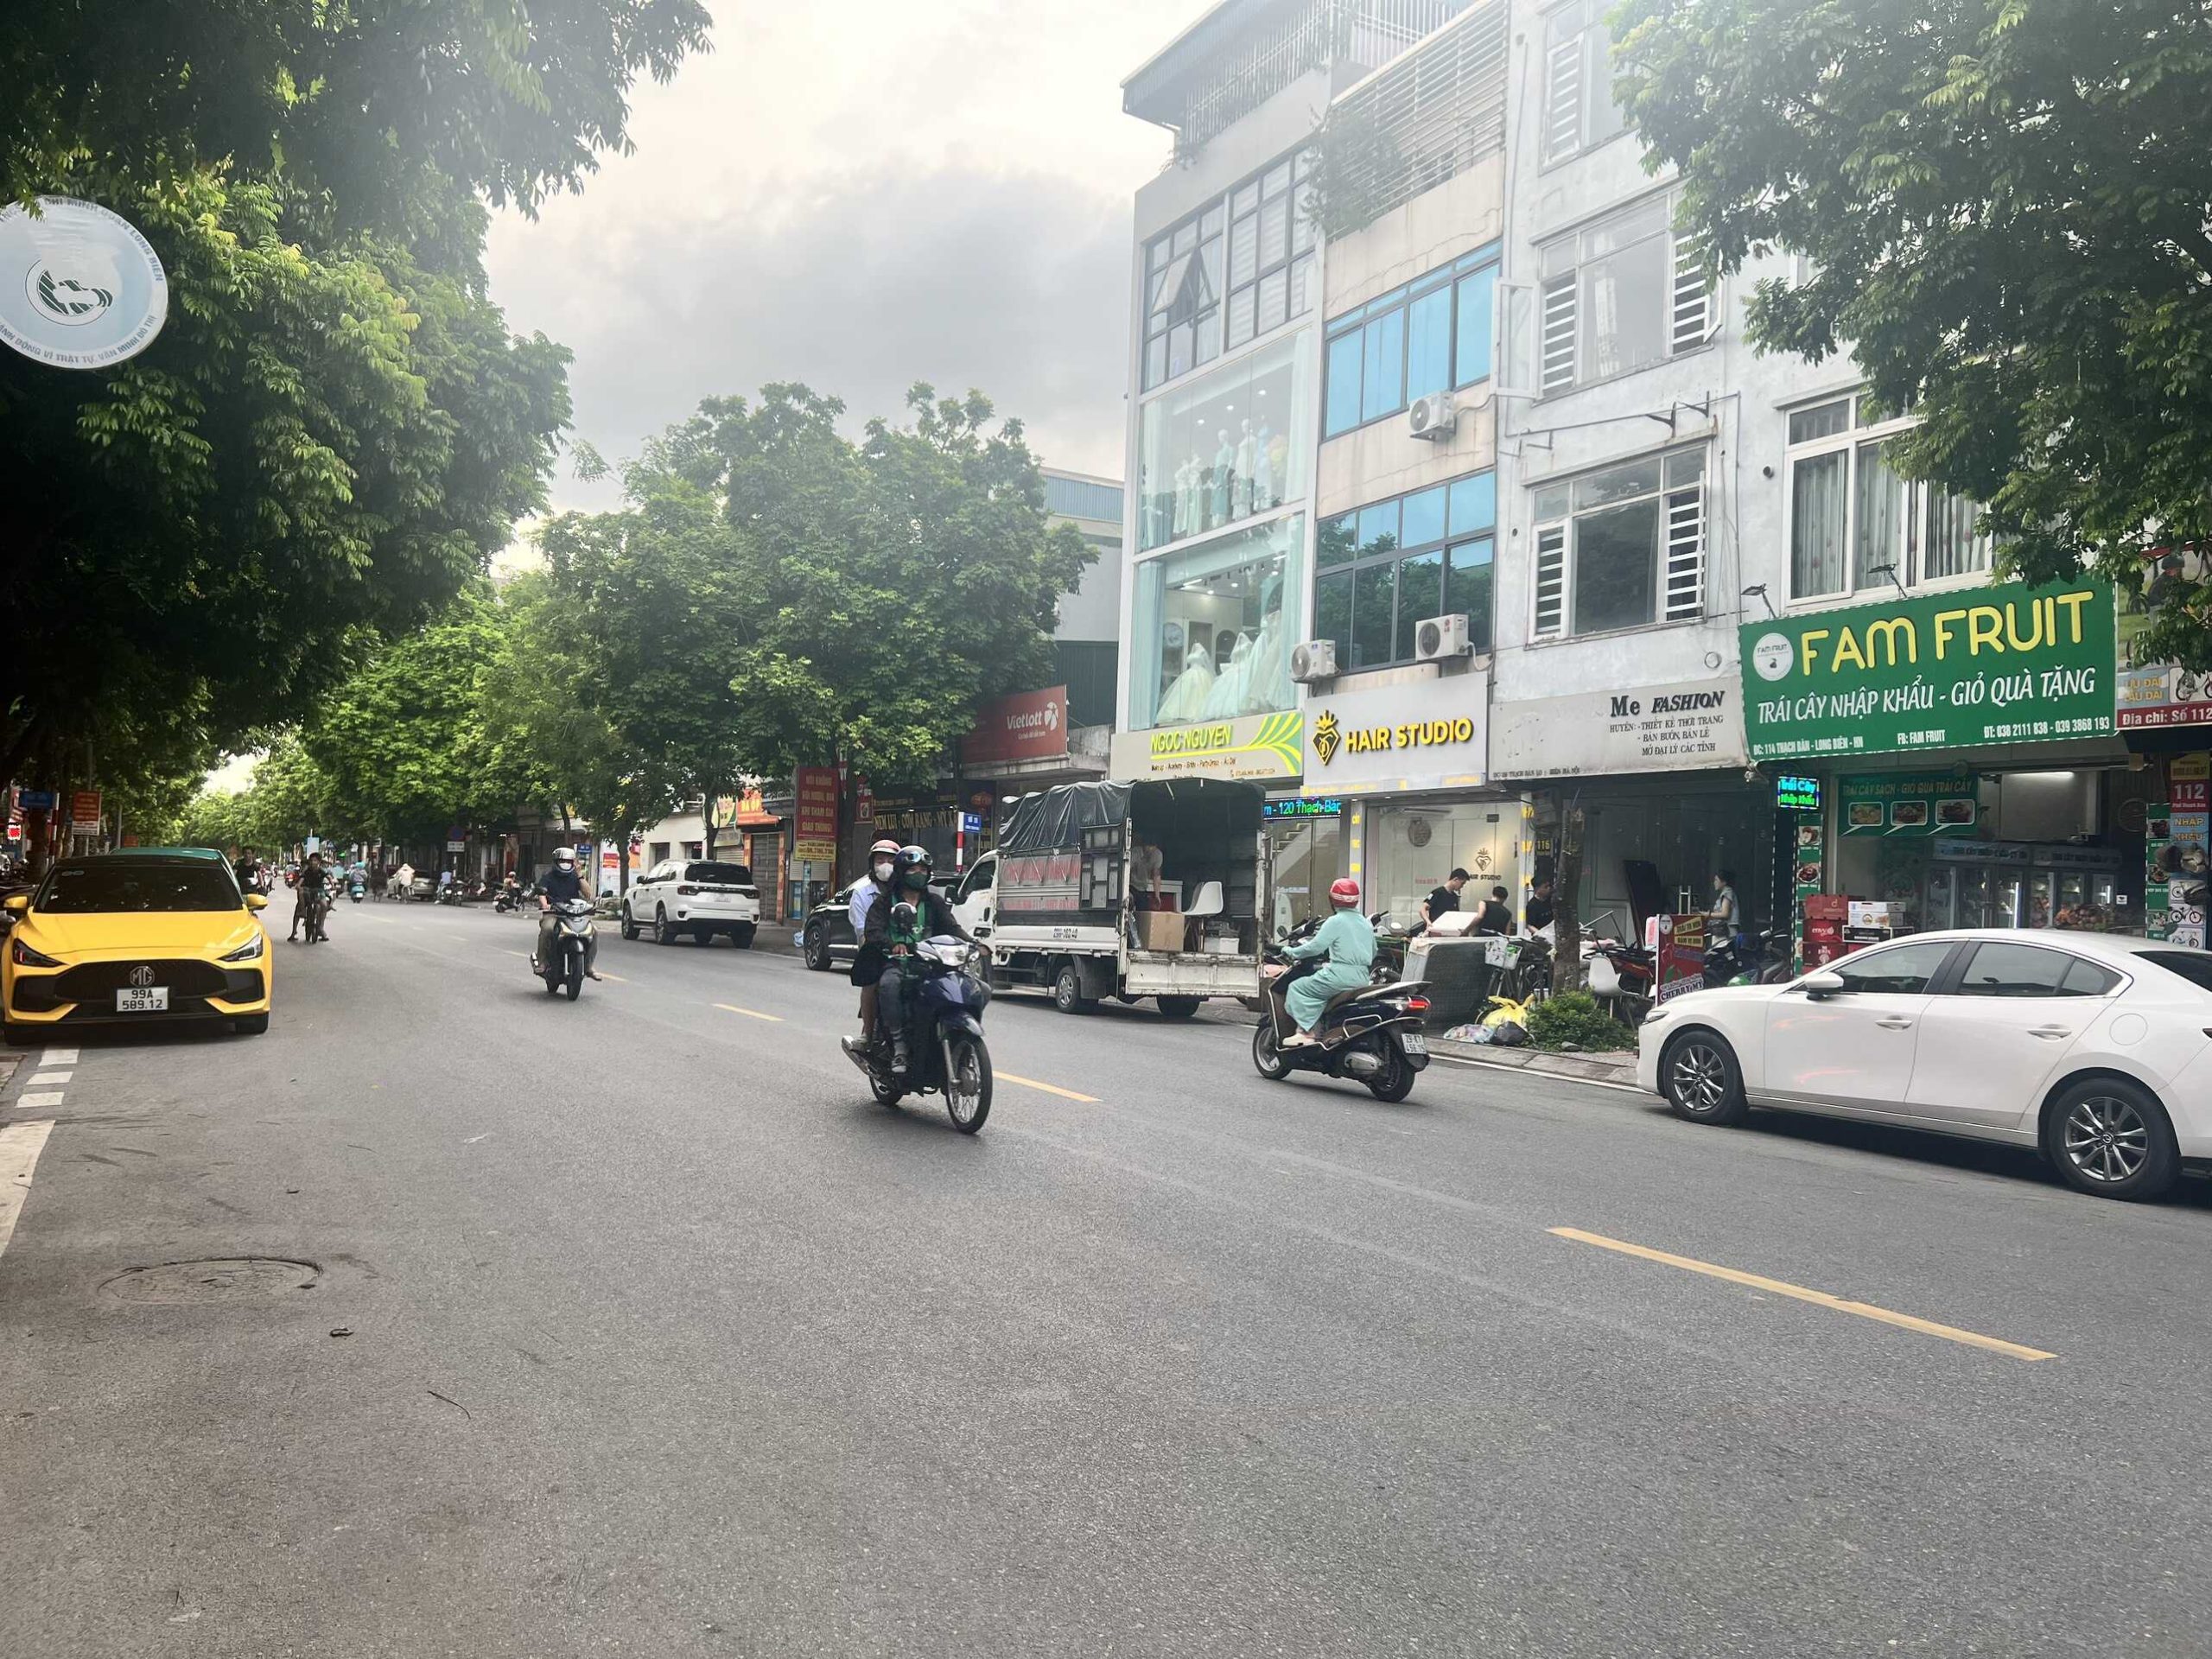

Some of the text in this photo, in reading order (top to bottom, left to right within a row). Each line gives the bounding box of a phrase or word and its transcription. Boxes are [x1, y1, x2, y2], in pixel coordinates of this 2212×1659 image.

[130, 229, 154, 256] LONG
[1802, 591, 2094, 677] FAM FRUIT
[1758, 695, 1791, 724] TRÁI
[1796, 692, 1827, 721] CÂY
[1831, 691, 1878, 720] NHẬP
[1883, 674, 1935, 713] KHẨU
[1951, 672, 1986, 706] GIỎ
[1990, 668, 2034, 709] QUÀ
[2040, 663, 2096, 702] TẶNG
[1611, 690, 1726, 717] Me FASHION
[1007, 709, 1042, 729] Vietlott
[1698, 715, 1724, 725] TRANG
[2171, 707, 2188, 721] Số
[2191, 707, 2212, 721] 112
[1997, 724, 2012, 737] 038
[2013, 723, 2031, 736] 2111
[2033, 721, 2048, 734] 838
[2056, 720, 2070, 733] 039
[2072, 718, 2092, 732] 3868
[2094, 716, 2110, 730] 193
[1345, 718, 1475, 753] HAIR STUDIO
[1910, 731, 1924, 743] FAM
[1926, 729, 1946, 742] FRUIT
[1764, 743, 1776, 754] 114
[1815, 739, 1832, 750] LONG
[2174, 783, 2205, 799] 112
[1279, 802, 1294, 814] 120
[131, 967, 153, 986] MG
[131, 988, 154, 999] 99A
[1660, 984, 1692, 1001] CHERRY
[122, 999, 162, 1010] 589.12
